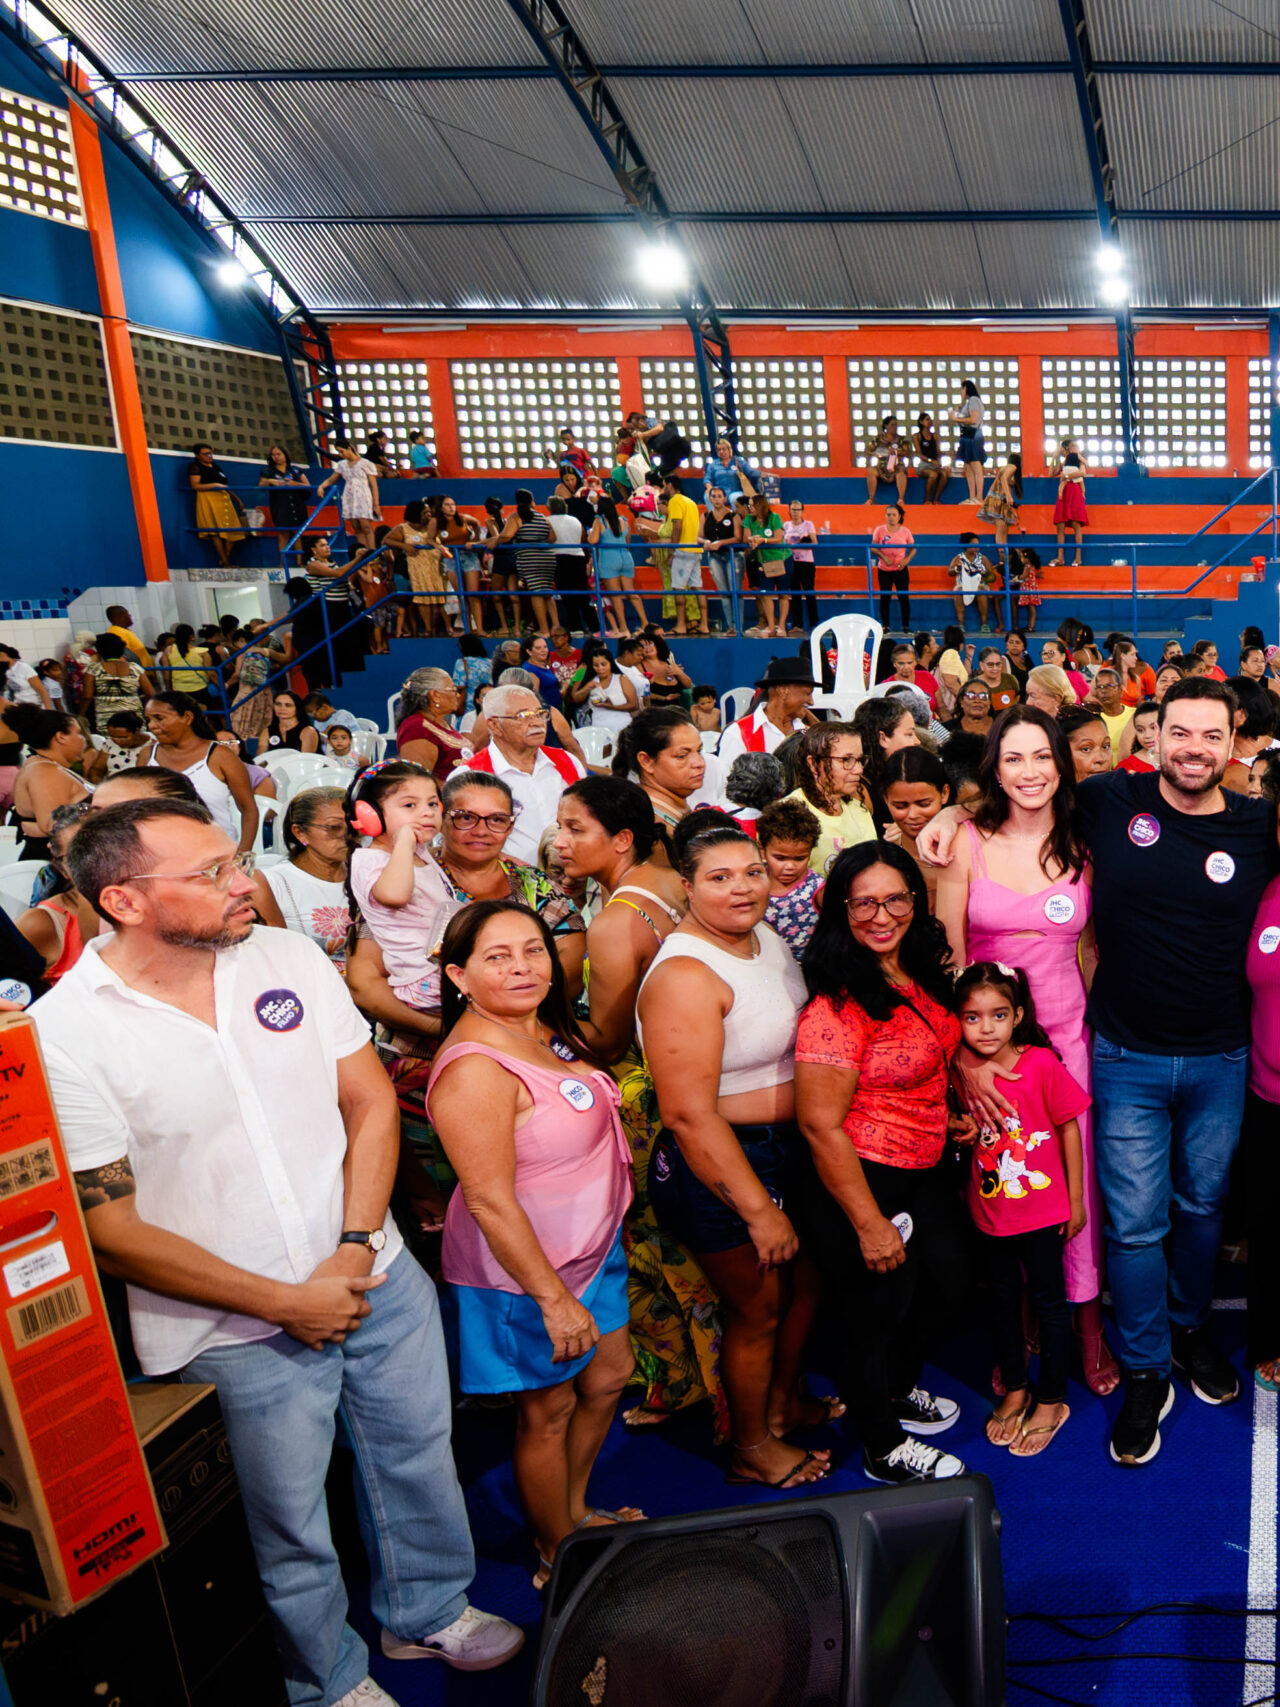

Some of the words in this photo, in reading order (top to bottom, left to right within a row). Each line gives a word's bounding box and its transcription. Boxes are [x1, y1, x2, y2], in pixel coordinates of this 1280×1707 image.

[1134, 824, 1154, 837] CHICO
[1211, 863, 1230, 873] CHICO
[260, 1001, 279, 1019] JHC
[268, 999, 295, 1024] CHICO
[74, 1513, 136, 1559] HDMI
